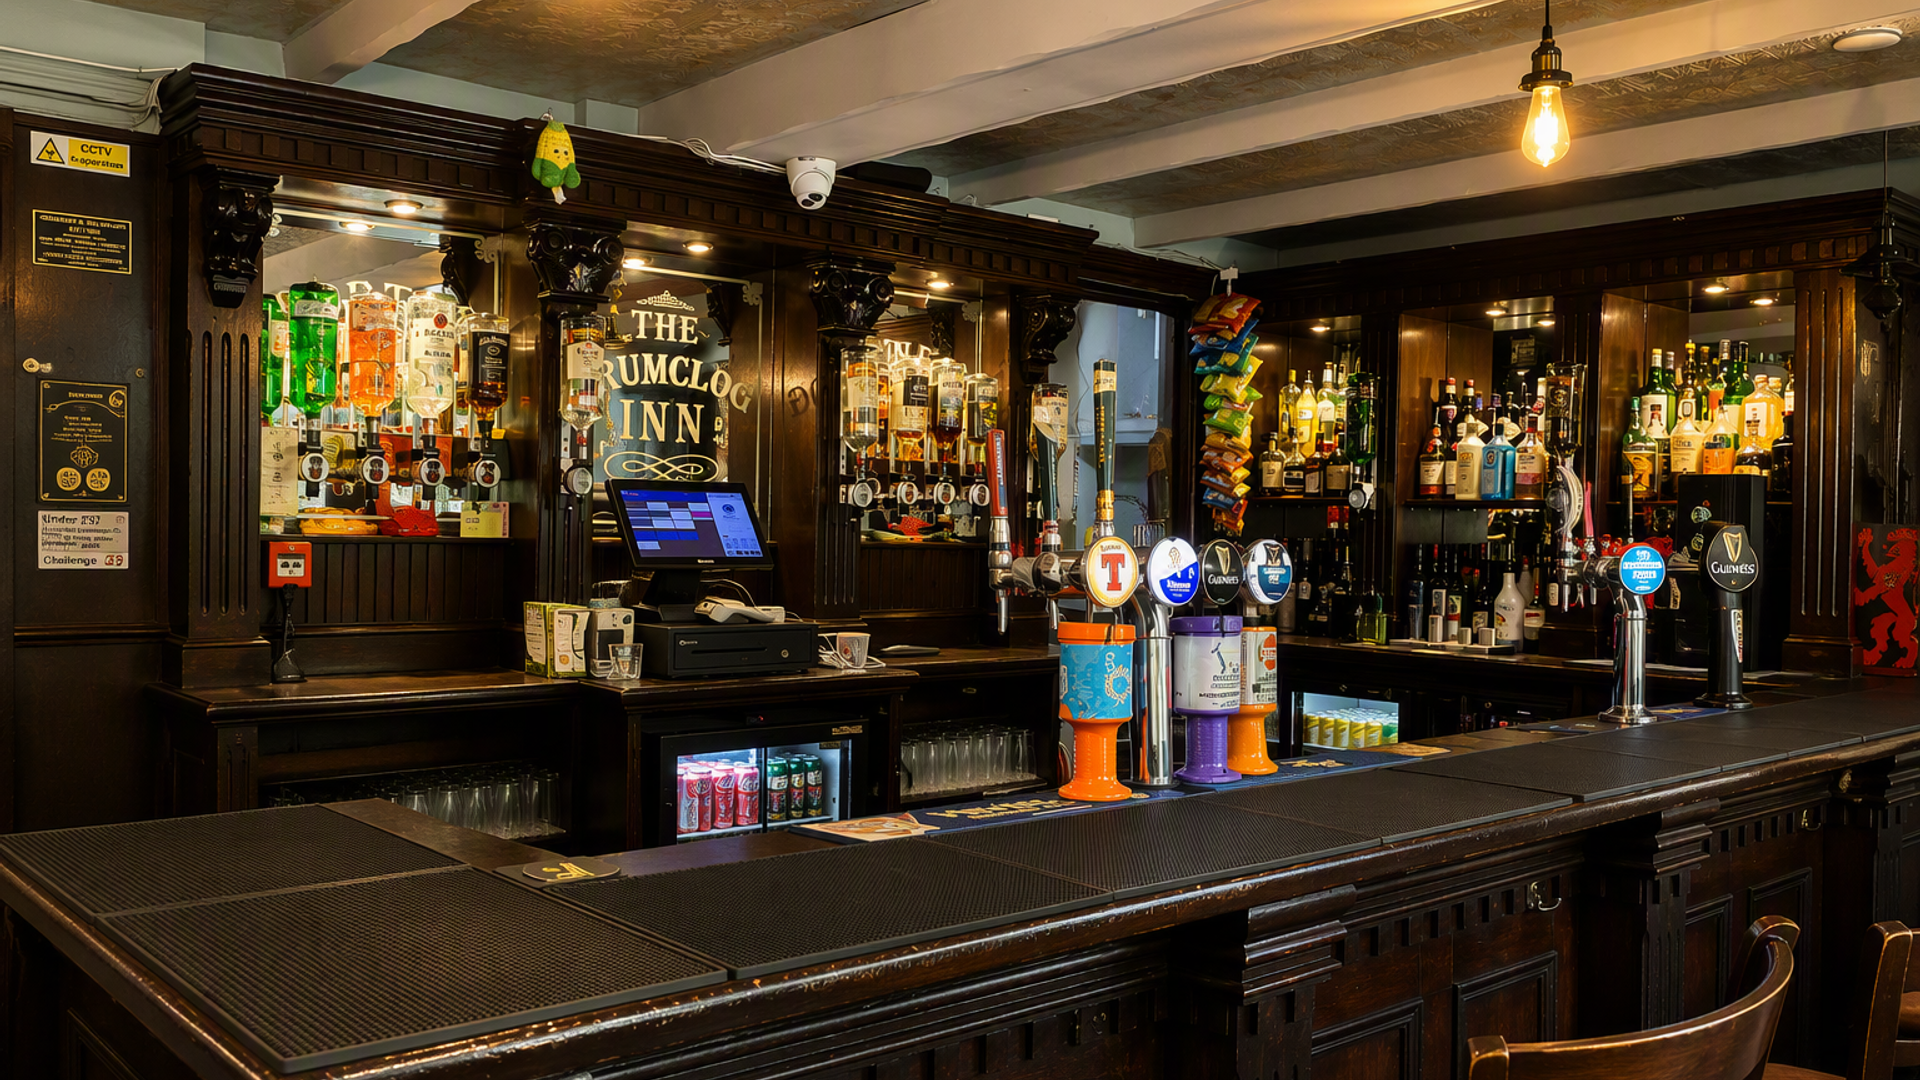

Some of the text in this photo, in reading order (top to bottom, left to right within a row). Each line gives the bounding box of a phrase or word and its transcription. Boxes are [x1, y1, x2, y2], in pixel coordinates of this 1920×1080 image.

[81, 143, 113, 157] CCTV
[631, 309, 699, 345] THE
[602, 353, 754, 414] RUMCLOG
[619, 398, 705, 444] INN
[1101, 553, 1125, 591] T
